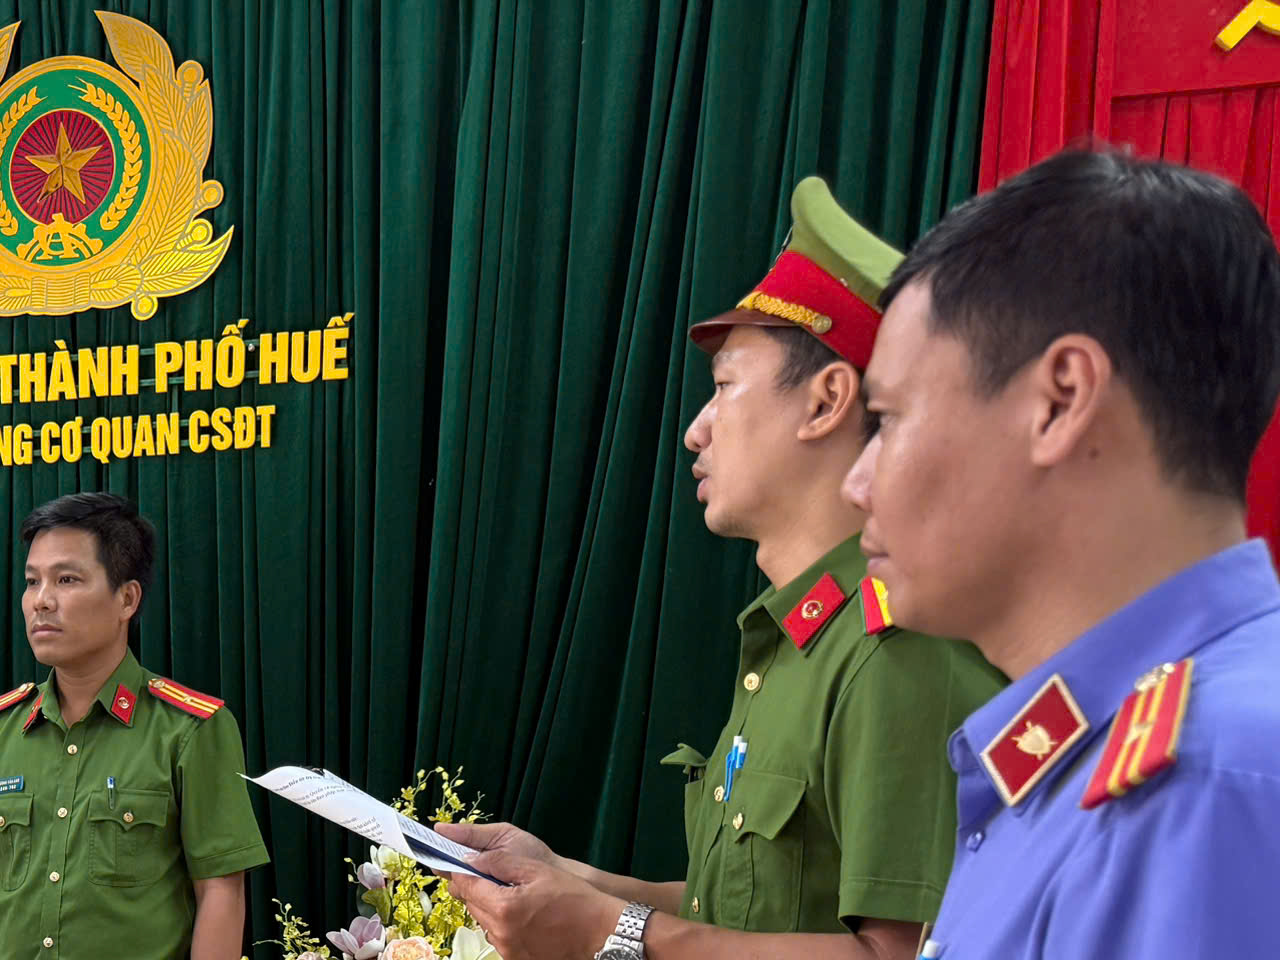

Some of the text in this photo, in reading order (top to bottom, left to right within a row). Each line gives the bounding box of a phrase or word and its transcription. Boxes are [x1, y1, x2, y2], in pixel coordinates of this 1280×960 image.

[154, 318, 250, 394] PHỐ
[258, 312, 356, 385] HUẾ
[40, 415, 84, 464] CƠ
[90, 411, 180, 464] QUAN
[188, 404, 276, 454] CSĐT
